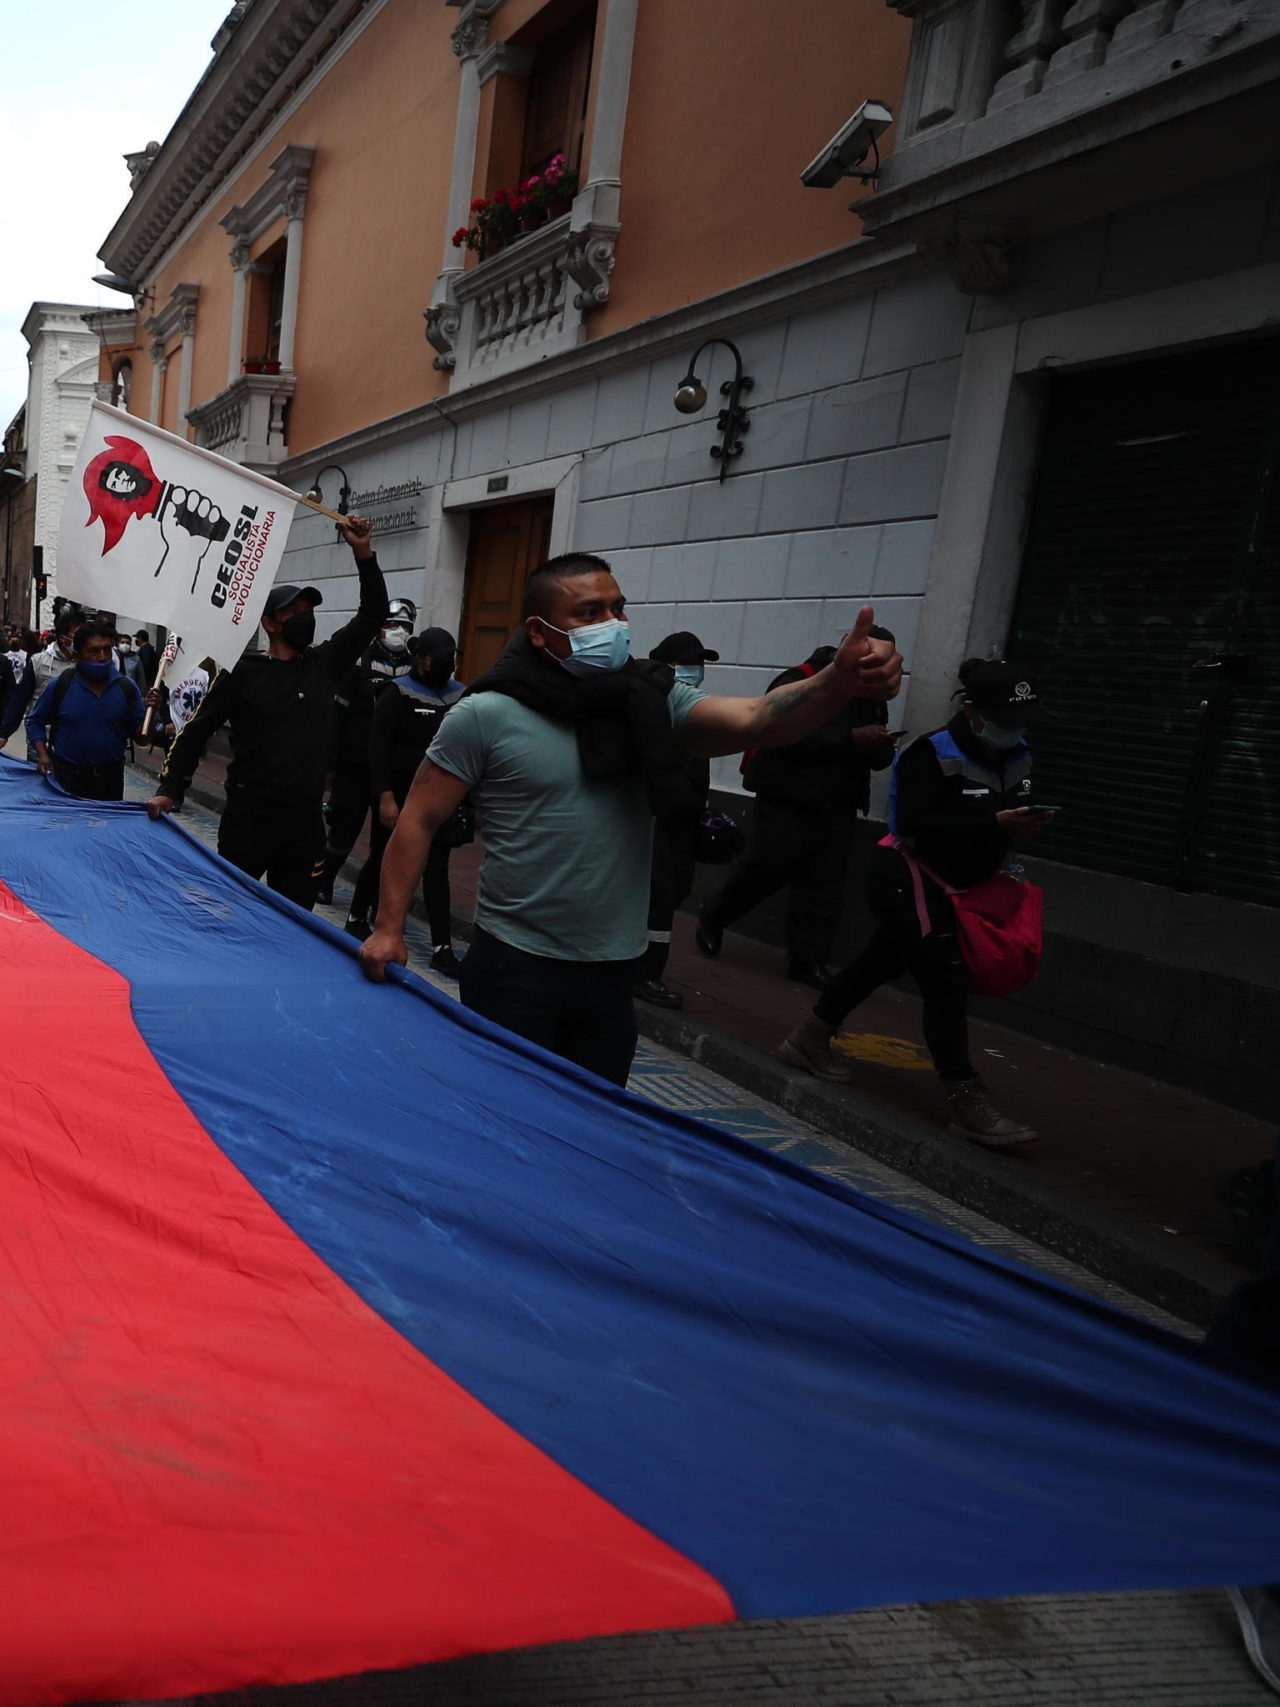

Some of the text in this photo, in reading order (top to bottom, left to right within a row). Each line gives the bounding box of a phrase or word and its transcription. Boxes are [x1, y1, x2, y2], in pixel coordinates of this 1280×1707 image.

[351, 475, 422, 509] Centro Comercial
[368, 505, 417, 532] ernacional
[210, 503, 259, 609] CEOSL
[228, 524, 261, 600] SOCIALISTA
[231, 510, 277, 626] REVOLUCIONARIA
